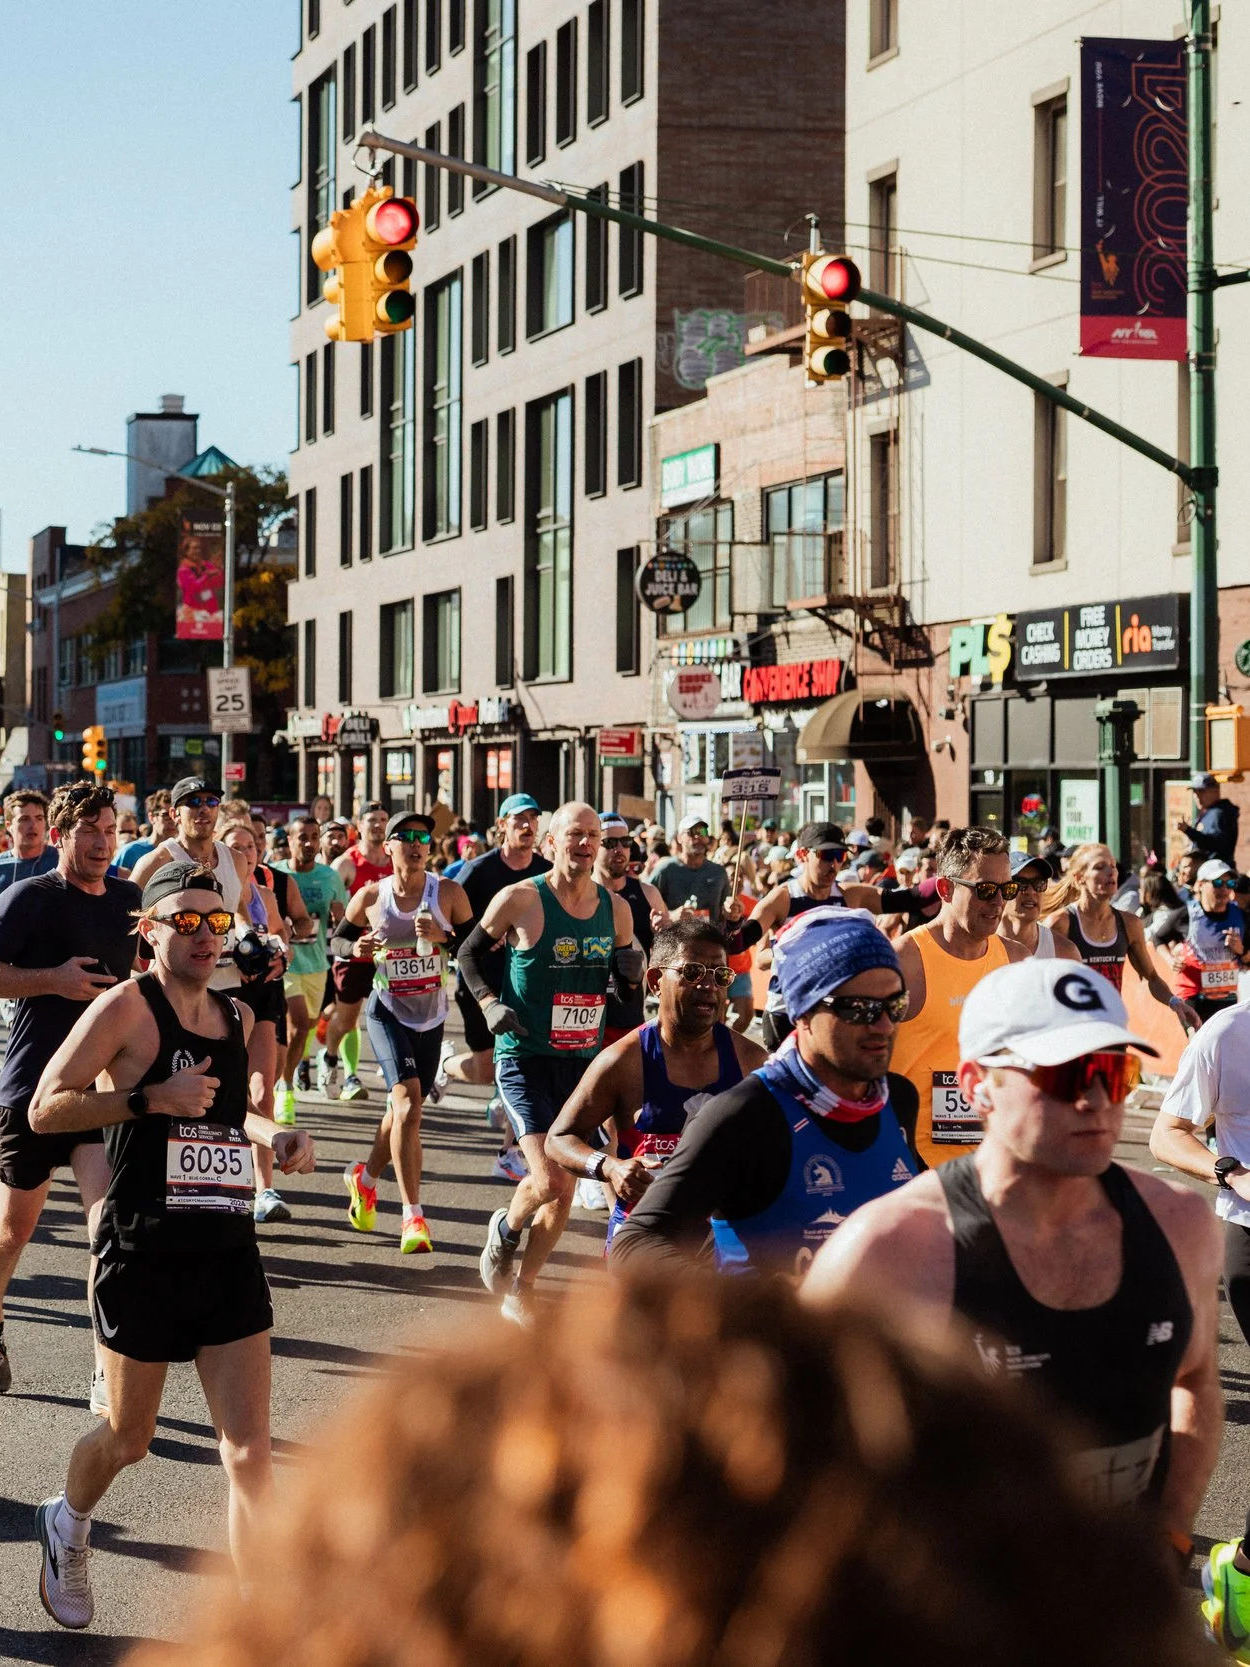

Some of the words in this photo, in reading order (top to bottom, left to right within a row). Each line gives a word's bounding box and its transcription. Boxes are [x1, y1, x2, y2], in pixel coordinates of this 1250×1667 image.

[655, 570, 678, 582] DELI
[680, 570, 688, 582] &
[645, 583, 675, 596] JUICE
[677, 583, 698, 595] BAR
[1080, 605, 1105, 628] FREE
[1026, 620, 1055, 643] CHECK
[1075, 626, 1110, 650] MONEY
[1122, 613, 1152, 655] ria
[1020, 642, 1061, 665] CASHING
[1073, 648, 1113, 671] ORDERS
[216, 694, 245, 712] 25
[732, 784, 769, 794] 3:15
[1066, 826, 1094, 841] MONEY
[392, 957, 435, 975] 13614
[1207, 970, 1235, 984] 8584
[560, 994, 574, 1004] tcs
[1053, 973, 1107, 1012] G
[562, 1007, 597, 1025] 7109
[179, 1058, 189, 1069] D
[942, 1073, 959, 1085] tcs
[945, 1090, 971, 1112] 59
[179, 1123, 197, 1138] tcs
[655, 1137, 675, 1150] tcs
[180, 1145, 243, 1176] 6035
